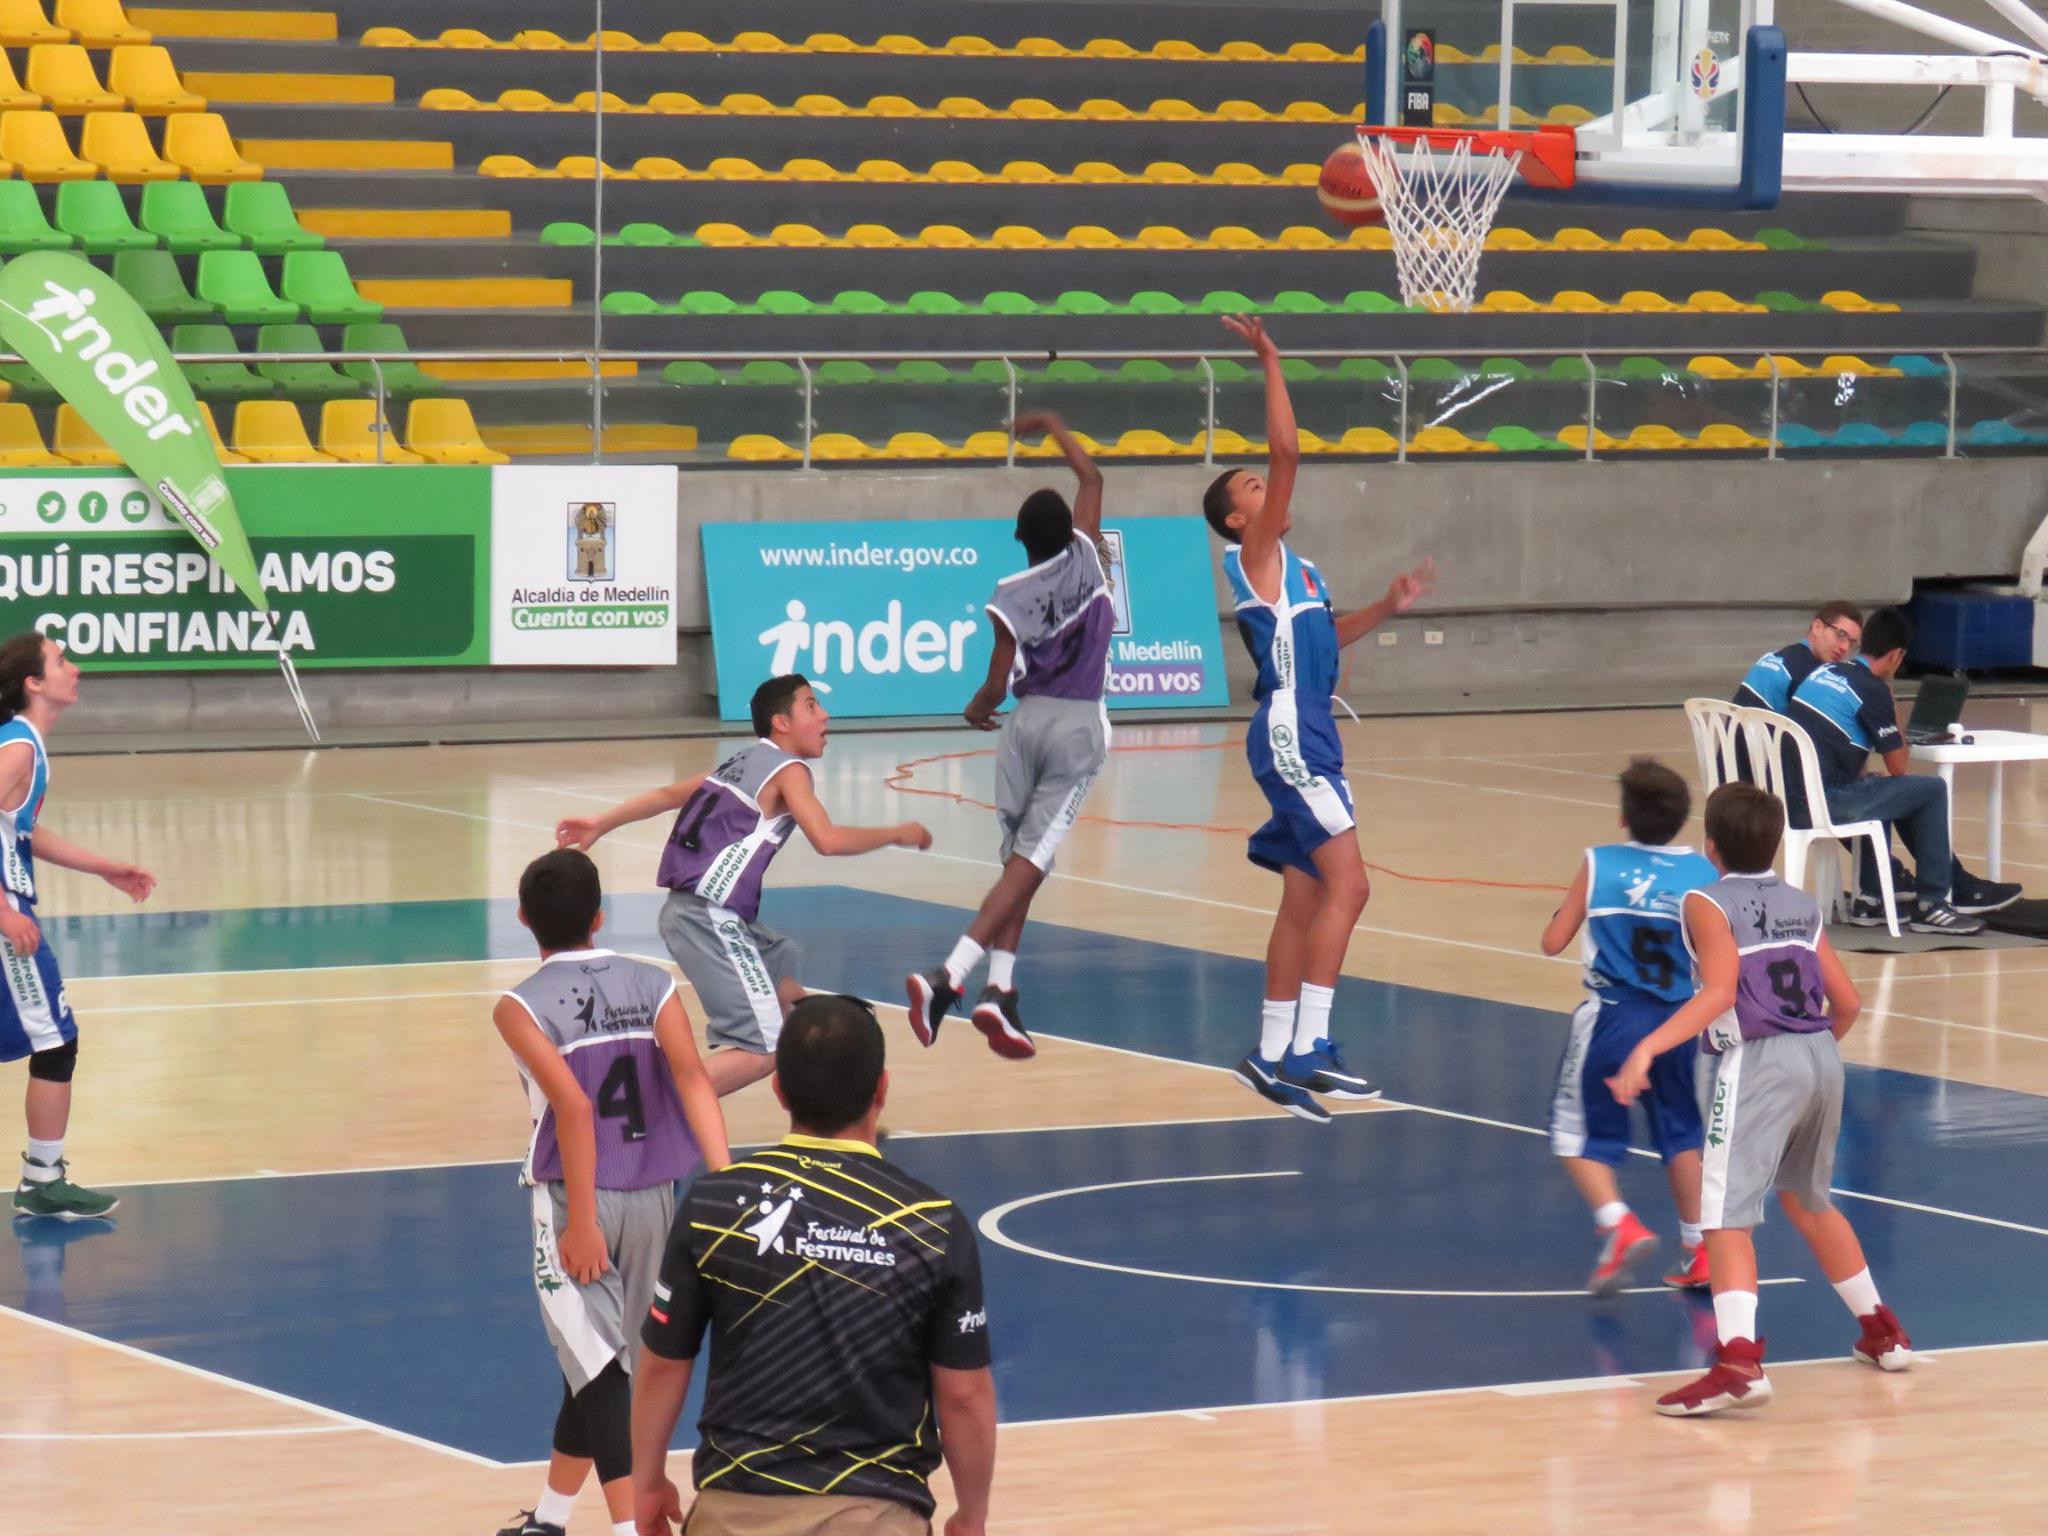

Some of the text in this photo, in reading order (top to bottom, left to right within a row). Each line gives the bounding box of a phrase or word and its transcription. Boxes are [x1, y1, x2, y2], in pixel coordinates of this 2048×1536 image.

[1408, 92, 1429, 110] FIBA
[27, 280, 193, 441] inder
[159, 483, 188, 516] Cuenta
[186, 514, 203, 533] con
[760, 541, 977, 572] www.inder.gov.co
[579, 587, 600, 603] de
[34, 610, 316, 654] CONFIANZA
[514, 608, 666, 628] Cuenta con vos
[759, 599, 978, 677] inder
[1118, 640, 1203, 661] Medellín
[1109, 672, 1202, 693] con vos
[712, 847, 750, 901] ANTIOQUIA
[4, 942, 28, 1002] ANTIOQUIA
[1632, 926, 1677, 990] 5
[596, 1055, 646, 1143] 4
[807, 1221, 887, 1247] Festival de
